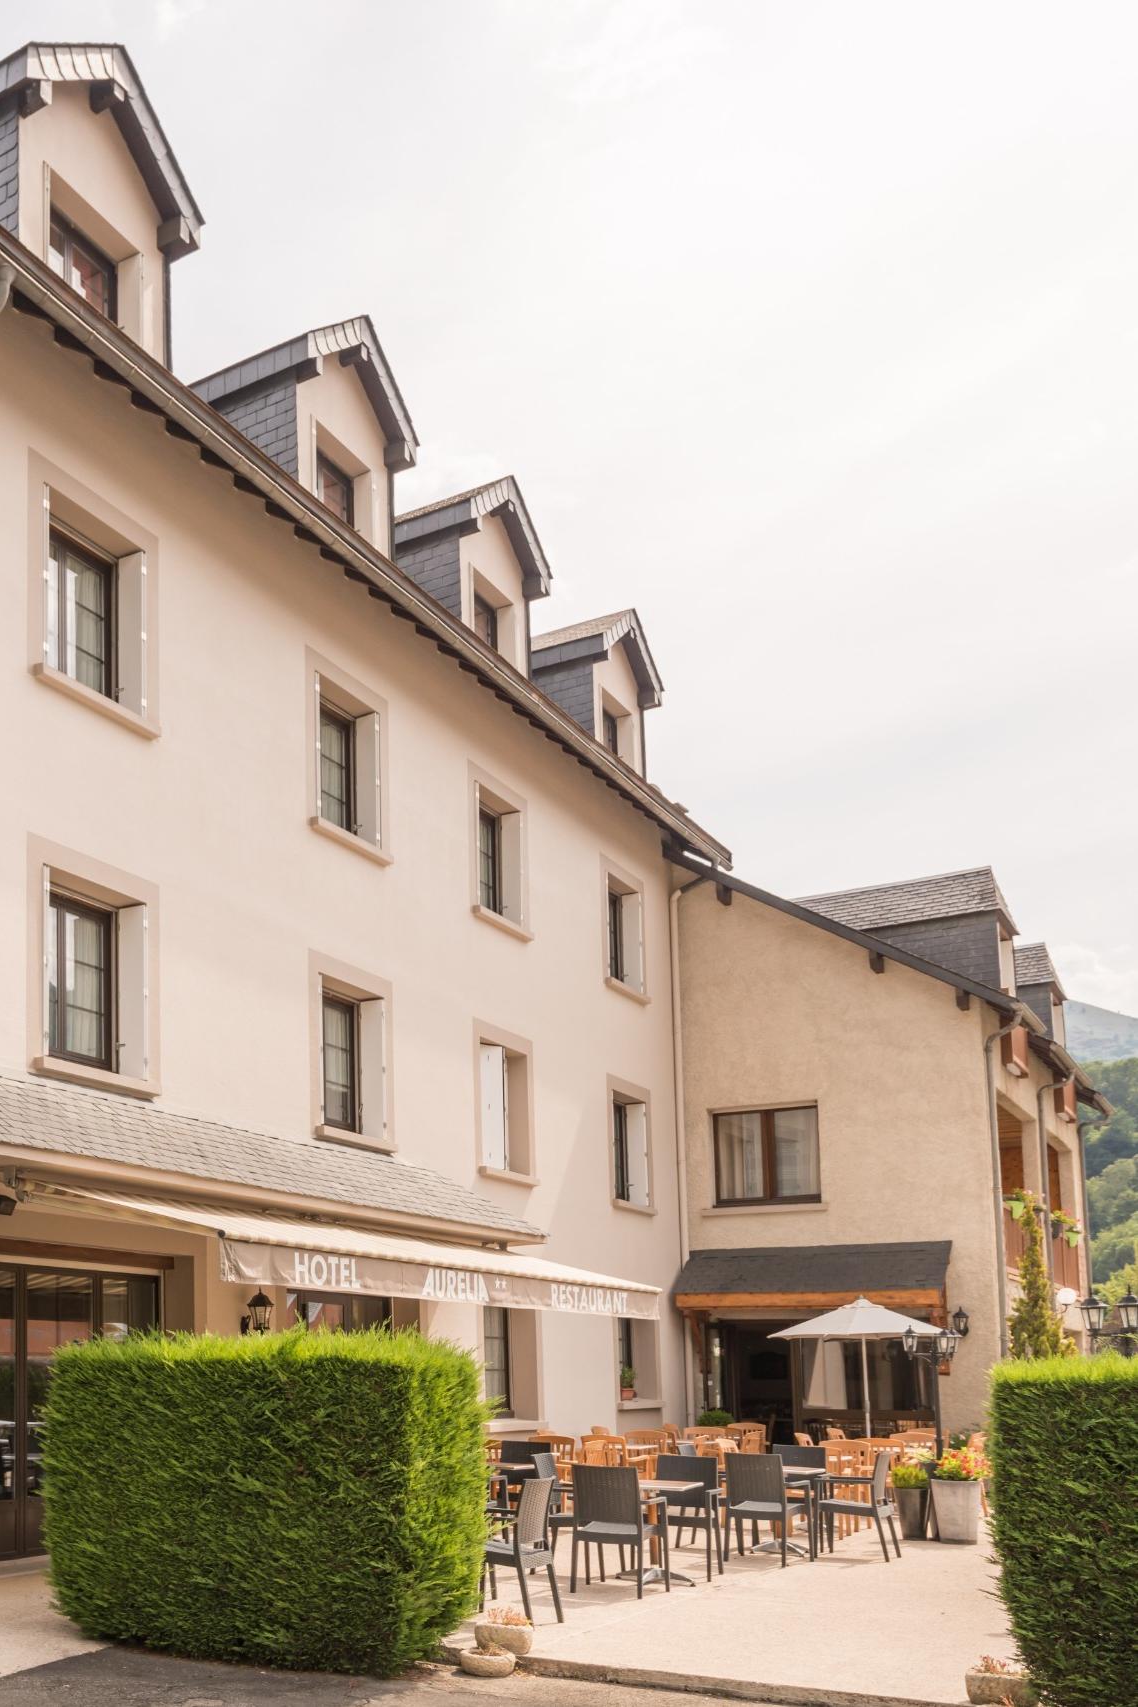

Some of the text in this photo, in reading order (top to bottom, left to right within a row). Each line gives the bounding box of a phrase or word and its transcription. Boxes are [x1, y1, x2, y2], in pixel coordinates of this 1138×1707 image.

[294, 1252, 628, 1313] HOTEL AURELIA RESTAURANT
